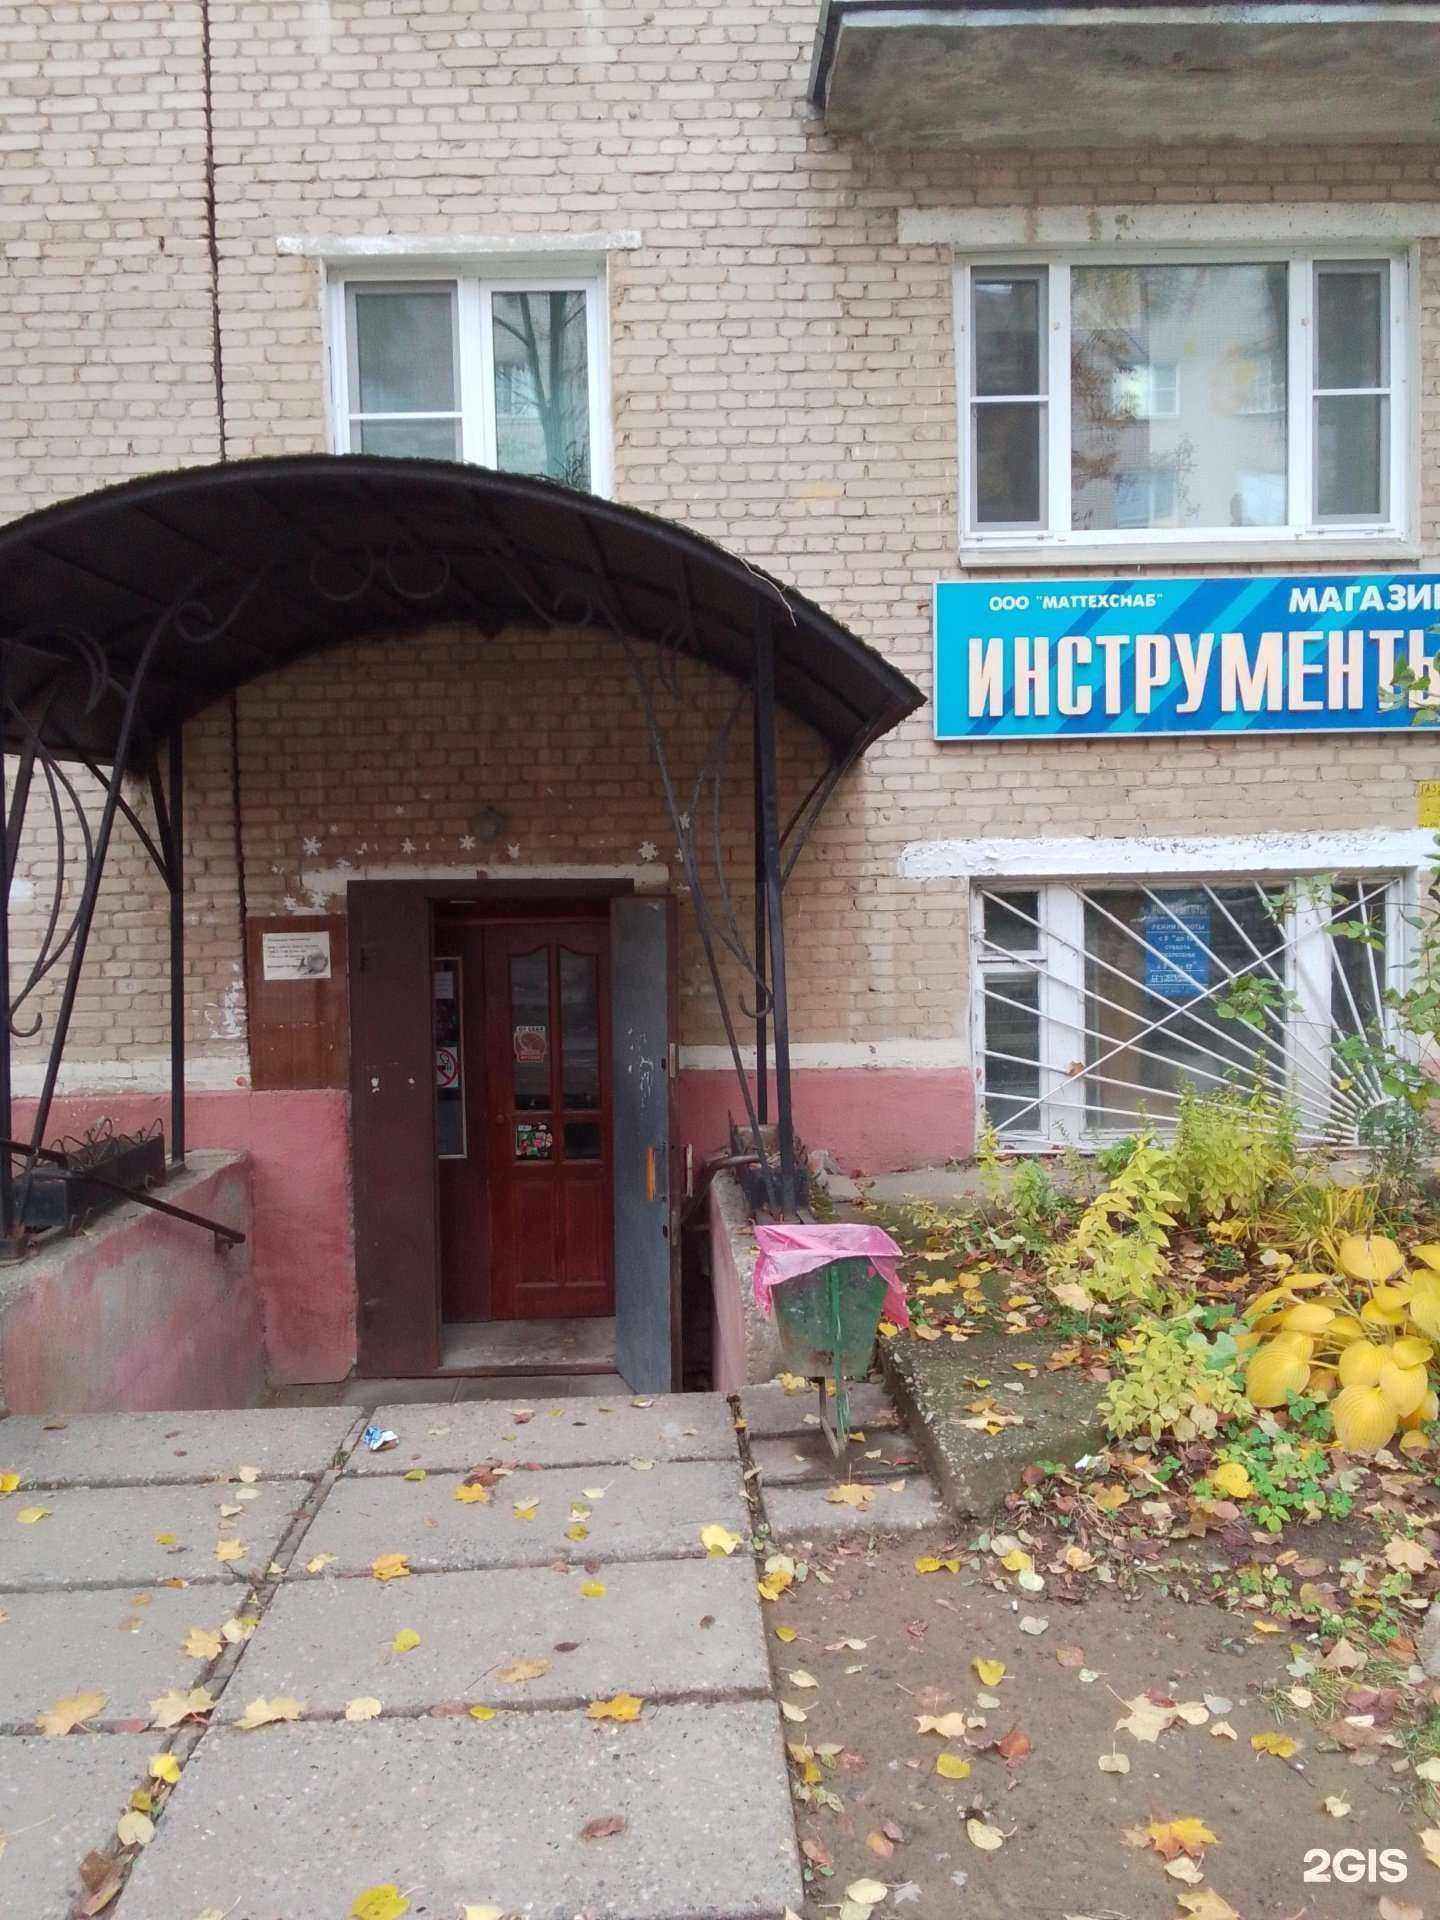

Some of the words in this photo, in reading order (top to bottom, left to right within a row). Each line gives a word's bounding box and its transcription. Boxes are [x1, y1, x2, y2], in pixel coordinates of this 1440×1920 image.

[989, 595, 1029, 611] ООО
[1036, 593, 1163, 610] "МАТТЕХСНАБ"
[1288, 584, 1440, 613] МАГАЗИ
